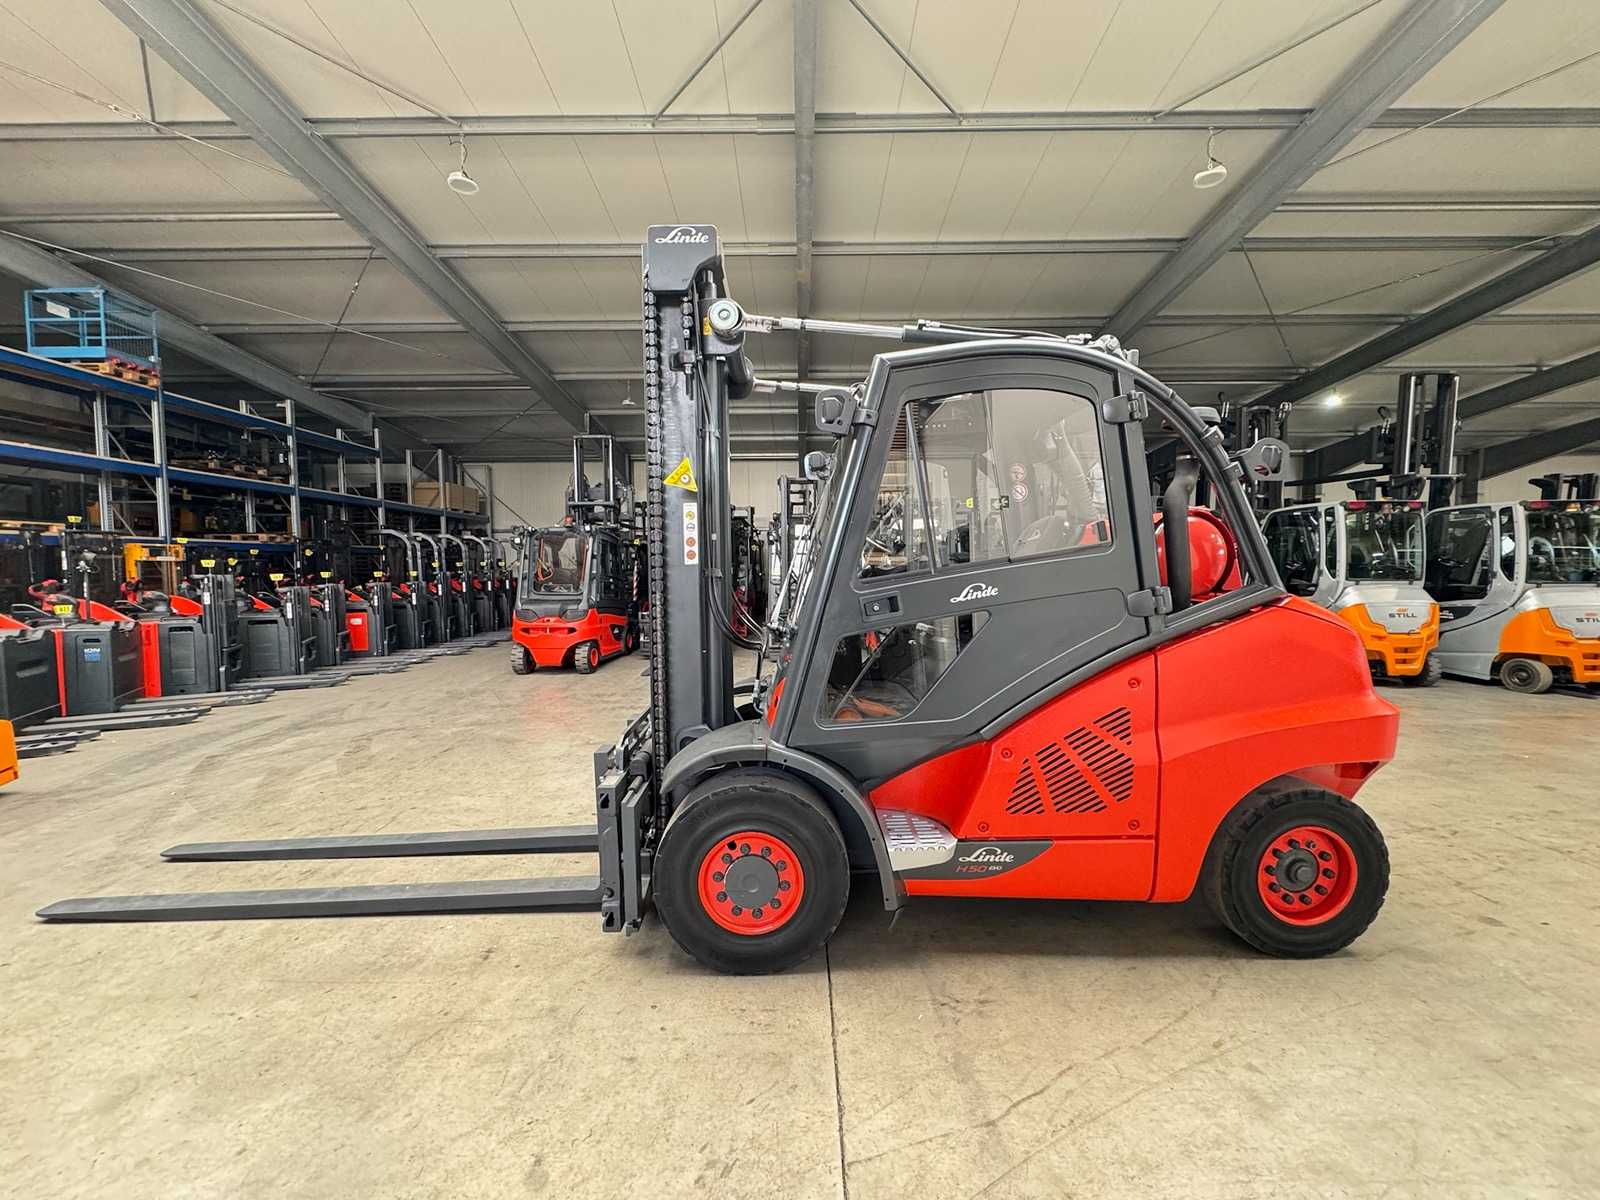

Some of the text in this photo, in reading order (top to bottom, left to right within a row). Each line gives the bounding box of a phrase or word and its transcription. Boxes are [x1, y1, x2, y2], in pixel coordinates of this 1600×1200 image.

[655, 226, 709, 244] Linde
[950, 583, 999, 603] Linde
[958, 846, 1014, 862] Linde
[956, 865, 987, 873] H50
